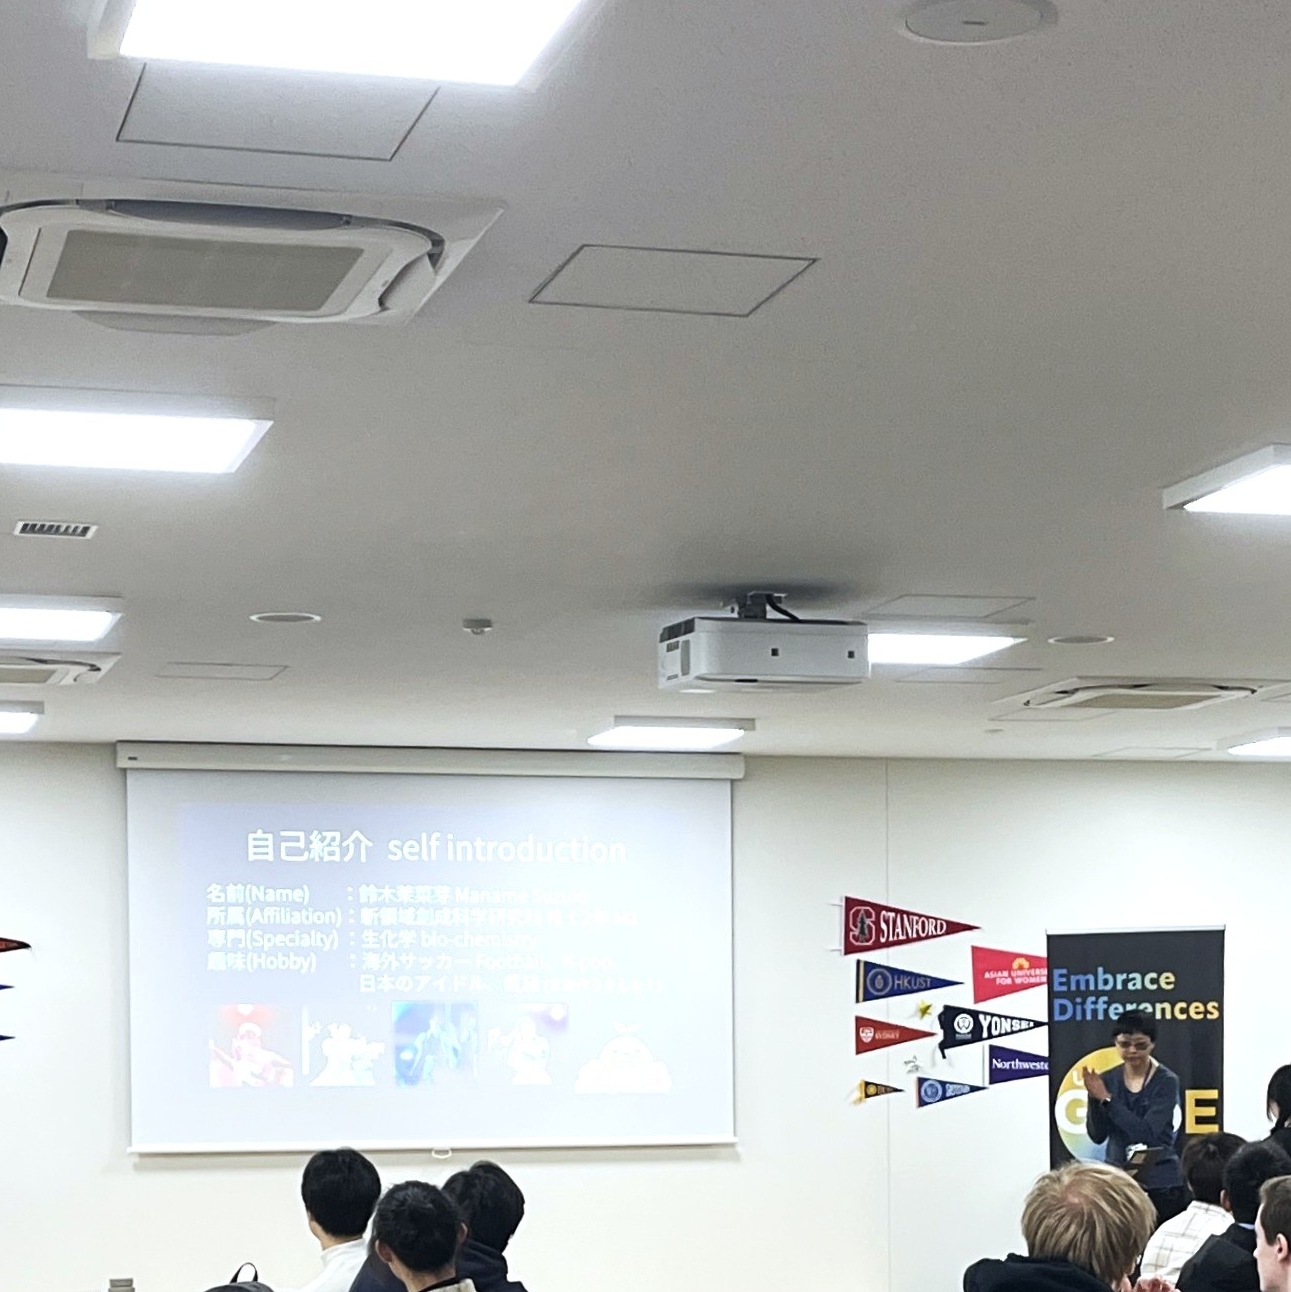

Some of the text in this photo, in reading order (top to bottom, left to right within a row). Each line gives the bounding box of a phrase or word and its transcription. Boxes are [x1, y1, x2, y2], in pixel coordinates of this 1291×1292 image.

[246, 829, 627, 864] 自己紹介 self introduction
[880, 910, 947, 943] STANFORD
[894, 974, 932, 990] HKUST
[984, 970, 1009, 979] ASIAN
[1052, 966, 1176, 992] Embrace
